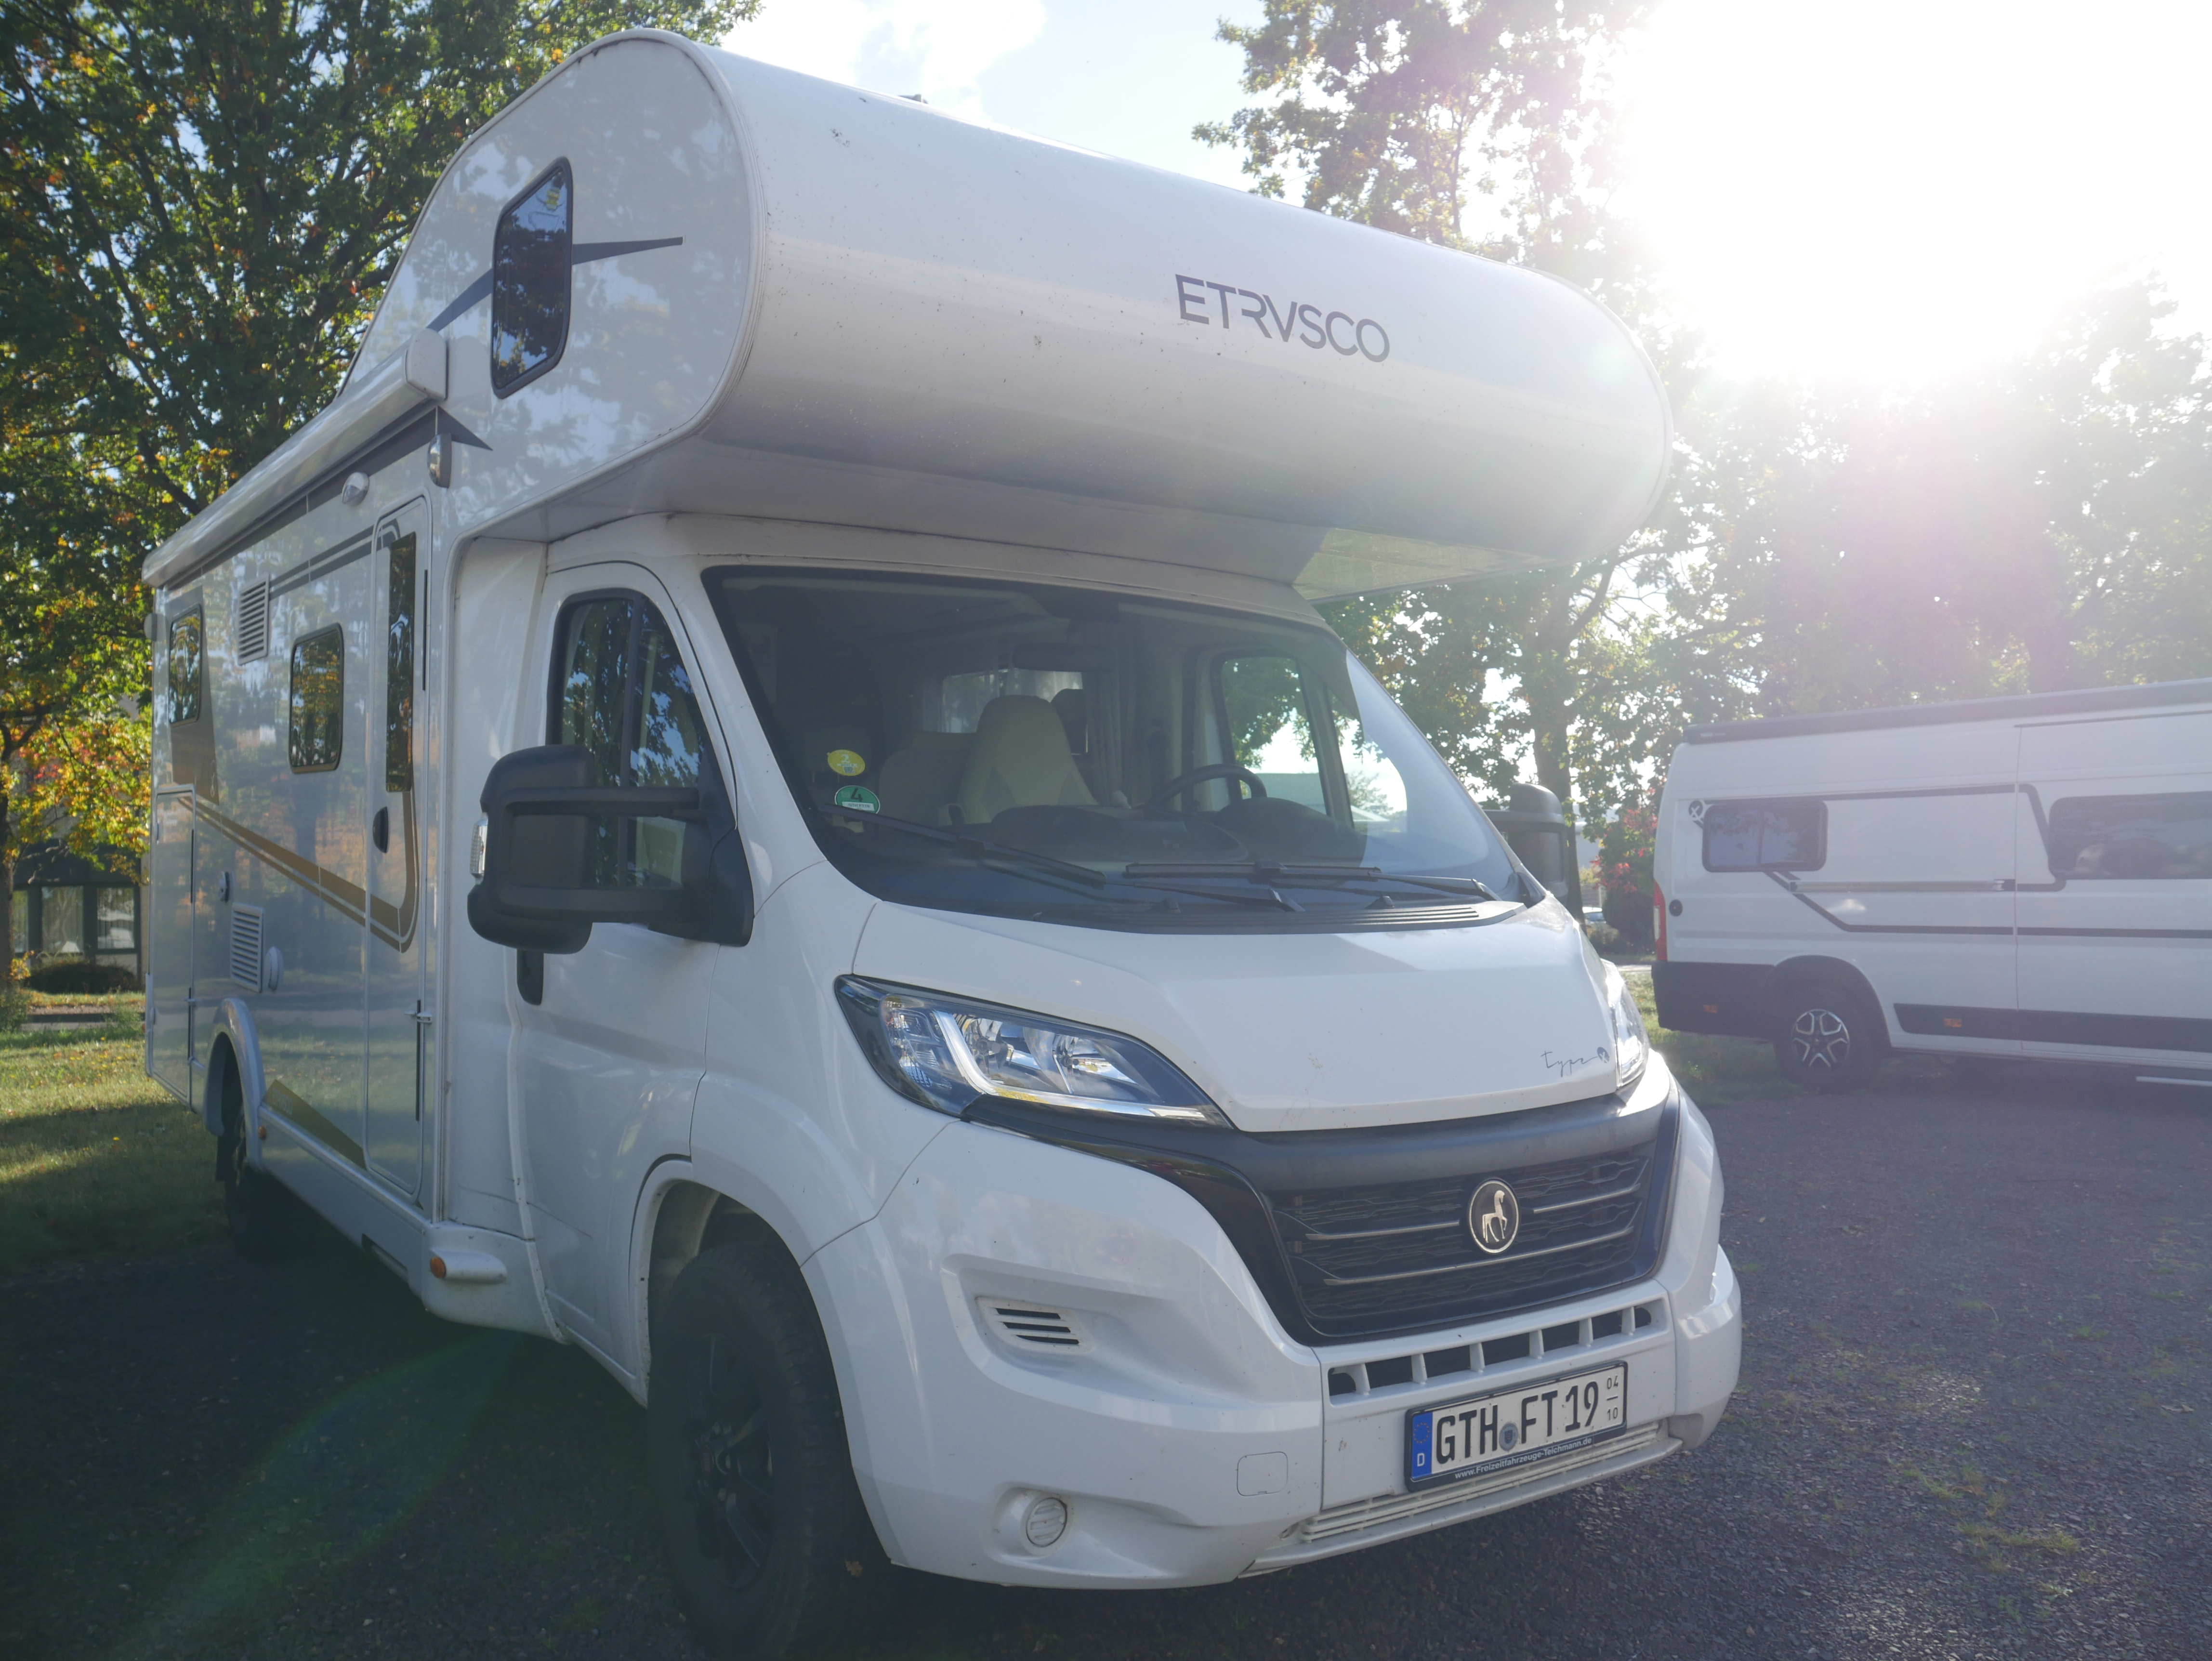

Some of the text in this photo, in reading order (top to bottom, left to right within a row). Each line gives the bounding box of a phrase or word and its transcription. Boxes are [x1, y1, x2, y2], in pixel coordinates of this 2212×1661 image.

[841, 754, 850, 763] 2
[850, 788, 863, 802] 4
[1606, 1375, 1619, 1390] 04
[1607, 1407, 1619, 1421] 10
[1435, 1404, 1498, 1464] GTH
[1417, 1452, 1425, 1467] D
[1454, 1437, 1593, 1479] www.Freizeitfahrzeuge-Teichmann.de
